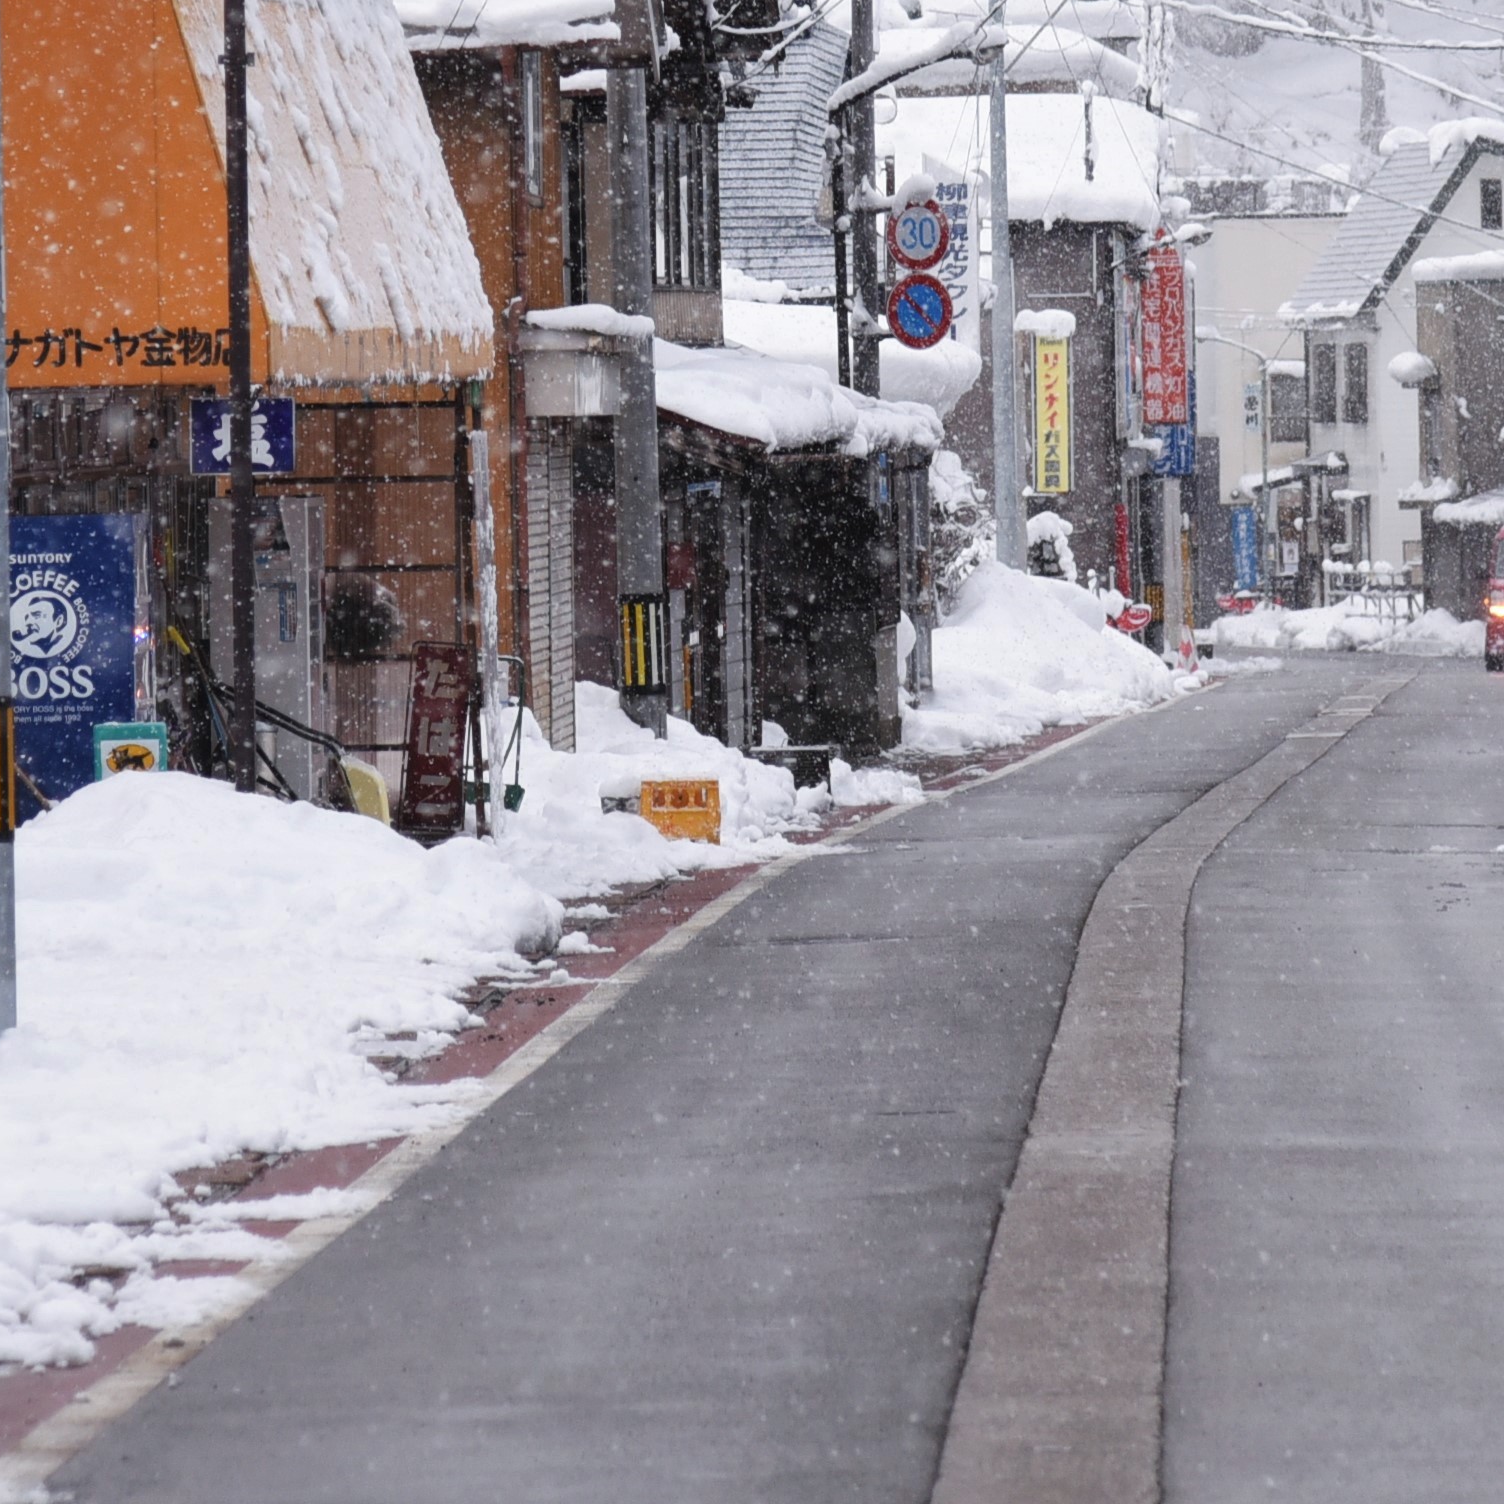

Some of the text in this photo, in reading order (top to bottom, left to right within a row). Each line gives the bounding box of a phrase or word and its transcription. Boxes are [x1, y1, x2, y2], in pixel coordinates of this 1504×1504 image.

[901, 217, 937, 250] 30
[211, 398, 275, 469] 塩
[8, 552, 73, 565] SUNTORY
[62, 597, 90, 664] BOSS COFFEE
[32, 705, 54, 713] BOSS
[64, 704, 75, 713] the
[77, 704, 94, 712] boss
[33, 715, 42, 723] all
